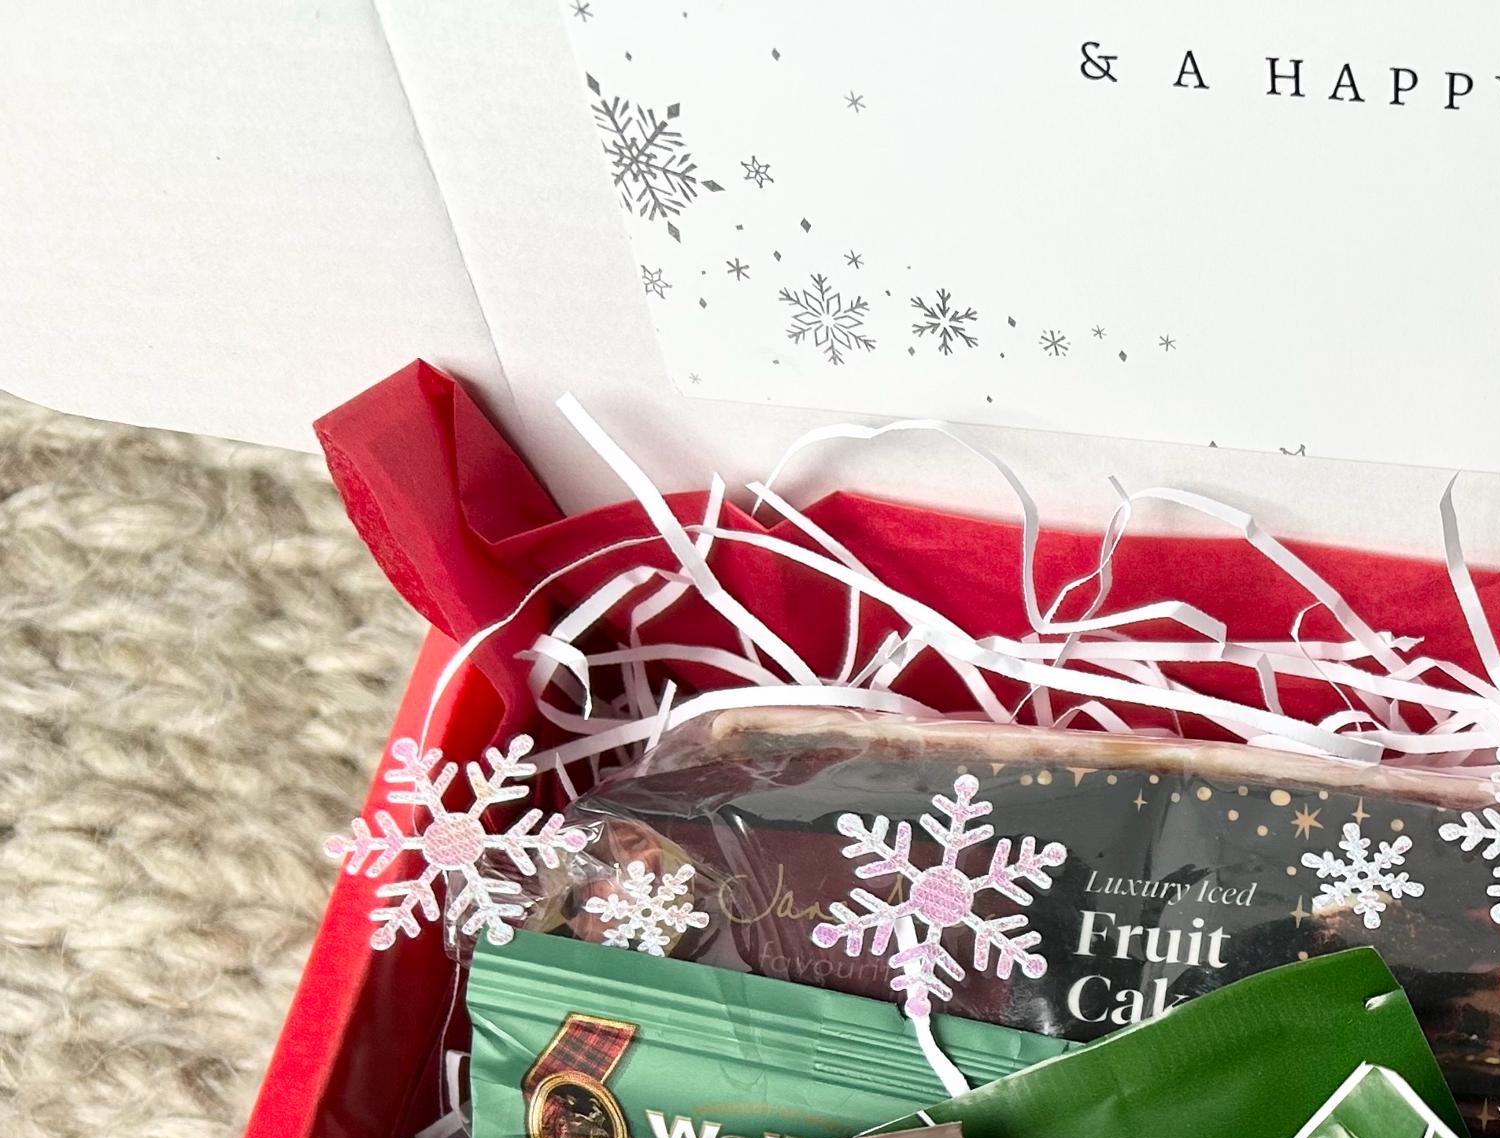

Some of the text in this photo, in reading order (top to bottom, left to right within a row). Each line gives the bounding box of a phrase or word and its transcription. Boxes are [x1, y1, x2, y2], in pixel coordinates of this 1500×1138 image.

[1079, 41, 1119, 84] &
[1172, 49, 1210, 90] A
[1084, 870, 1258, 907] Luxury Iced
[1072, 909, 1232, 969] Fruit
[1067, 973, 1190, 1026] Cak
